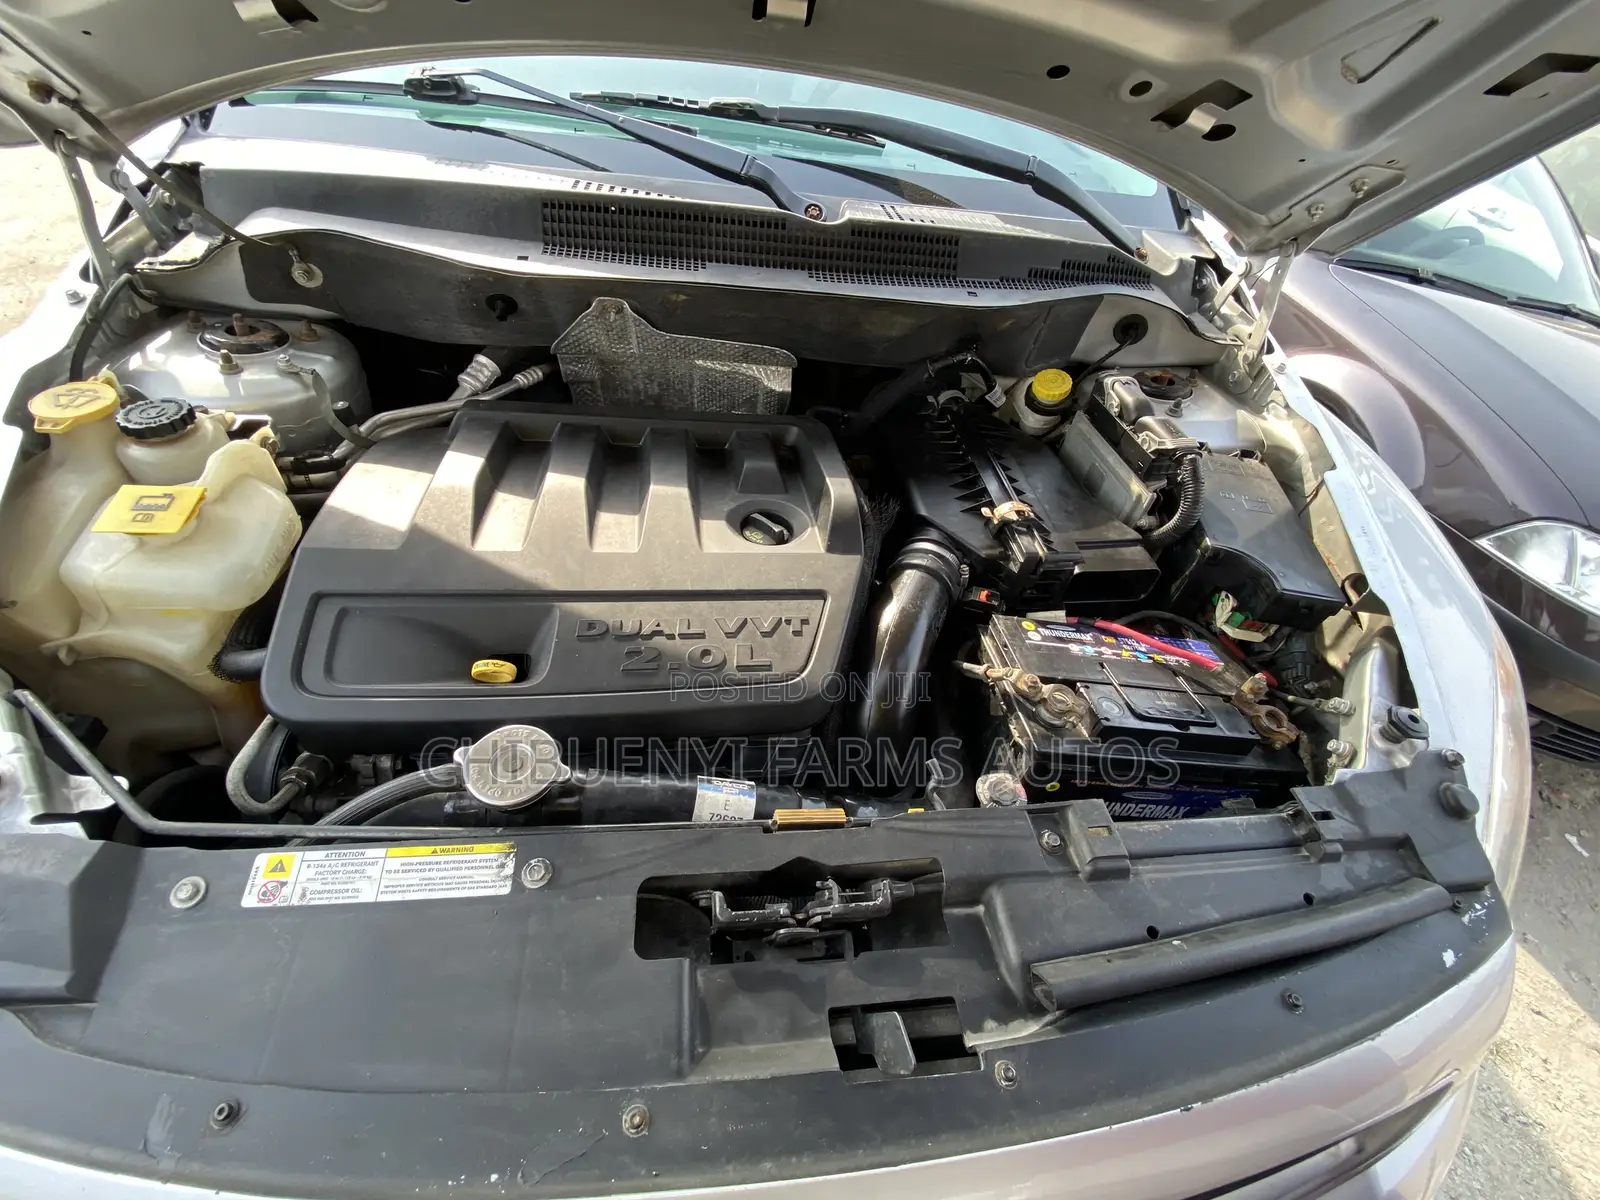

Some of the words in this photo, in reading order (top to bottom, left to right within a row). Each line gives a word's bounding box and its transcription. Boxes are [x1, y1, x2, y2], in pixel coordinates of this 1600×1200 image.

[576, 618, 706, 640] DUAL
[714, 616, 810, 639] VVT
[620, 643, 773, 672] 2.0L
[439, 846, 475, 854] WARNING
[324, 851, 366, 859] ATTENTION
[340, 860, 379, 868] REFRIGERANT
